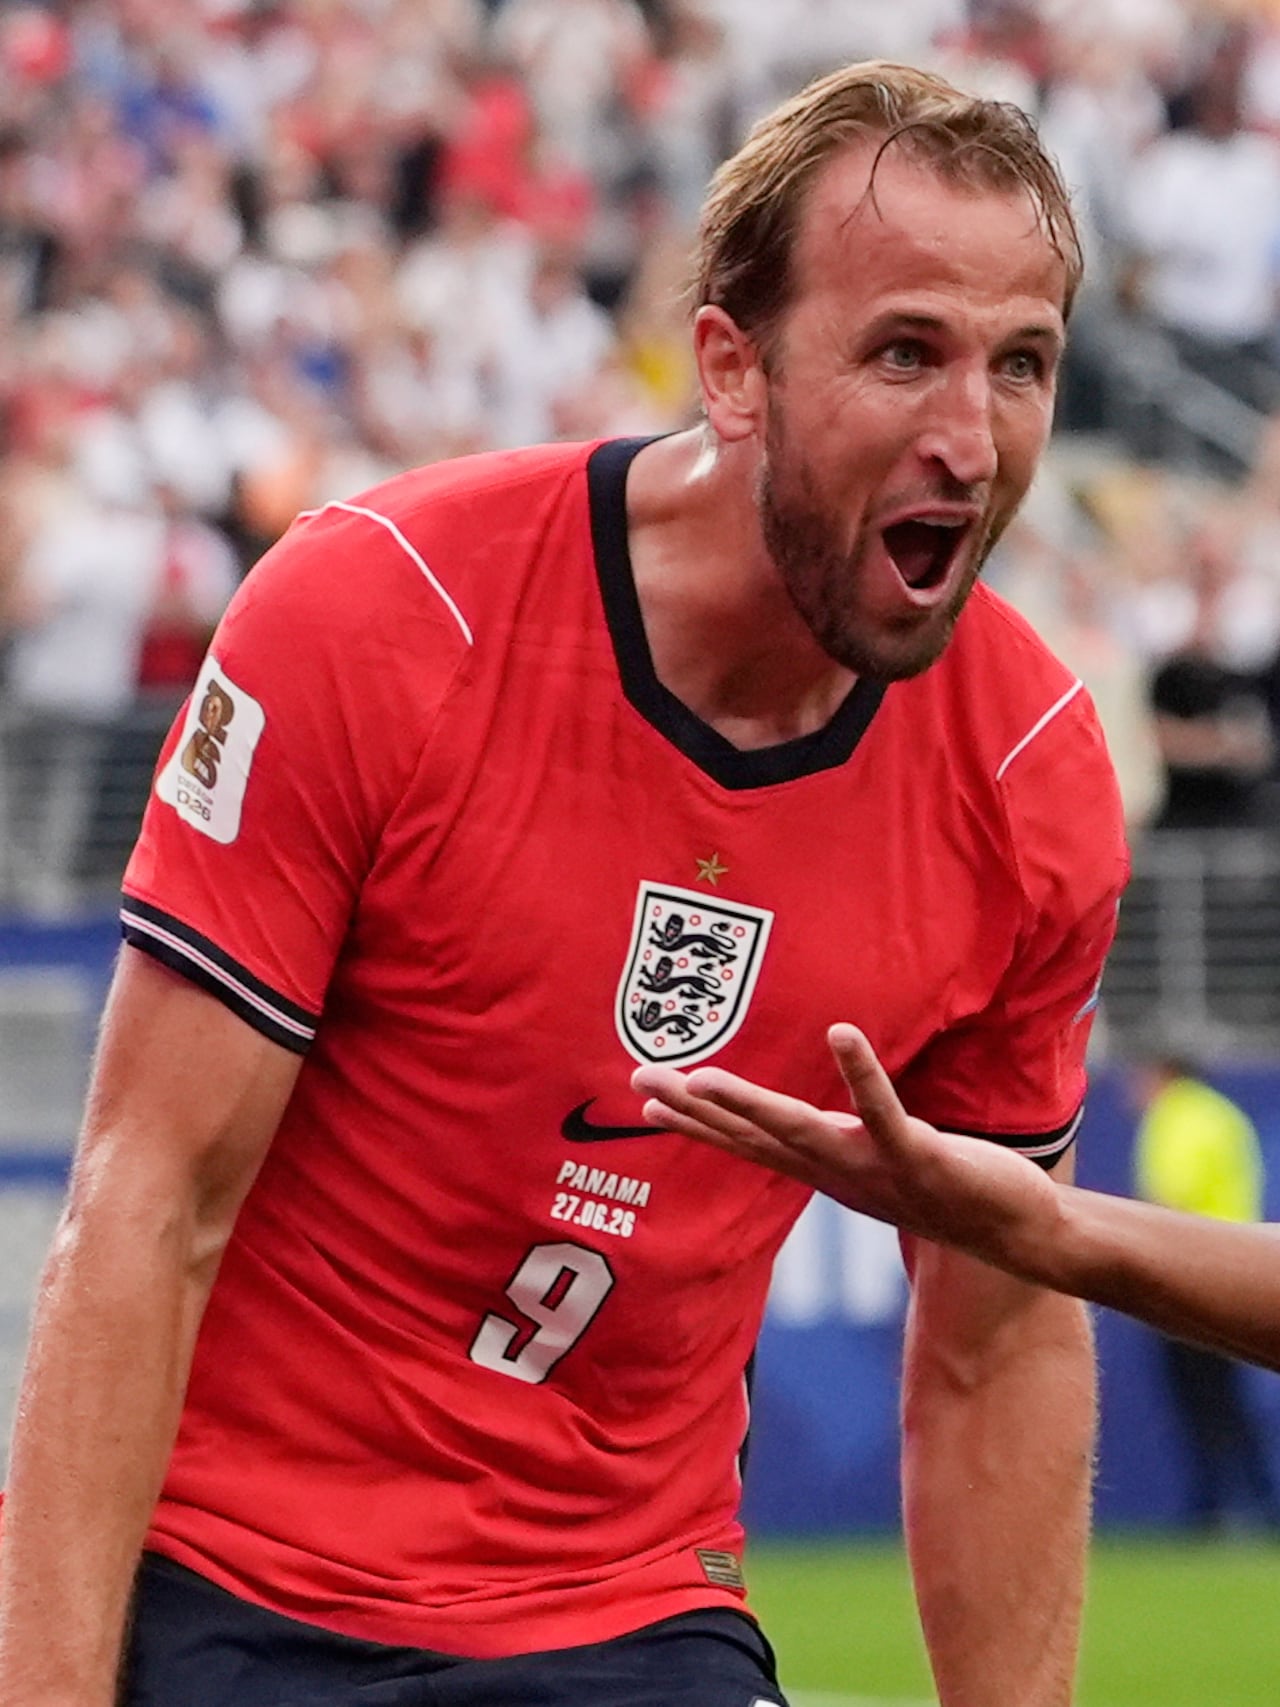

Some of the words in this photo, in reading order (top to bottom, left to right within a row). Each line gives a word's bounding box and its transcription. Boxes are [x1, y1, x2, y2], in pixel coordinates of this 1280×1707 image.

[556, 1159, 651, 1208] PANAMA
[550, 1192, 636, 1238] 27.06.26
[469, 1242, 615, 1385] 9
